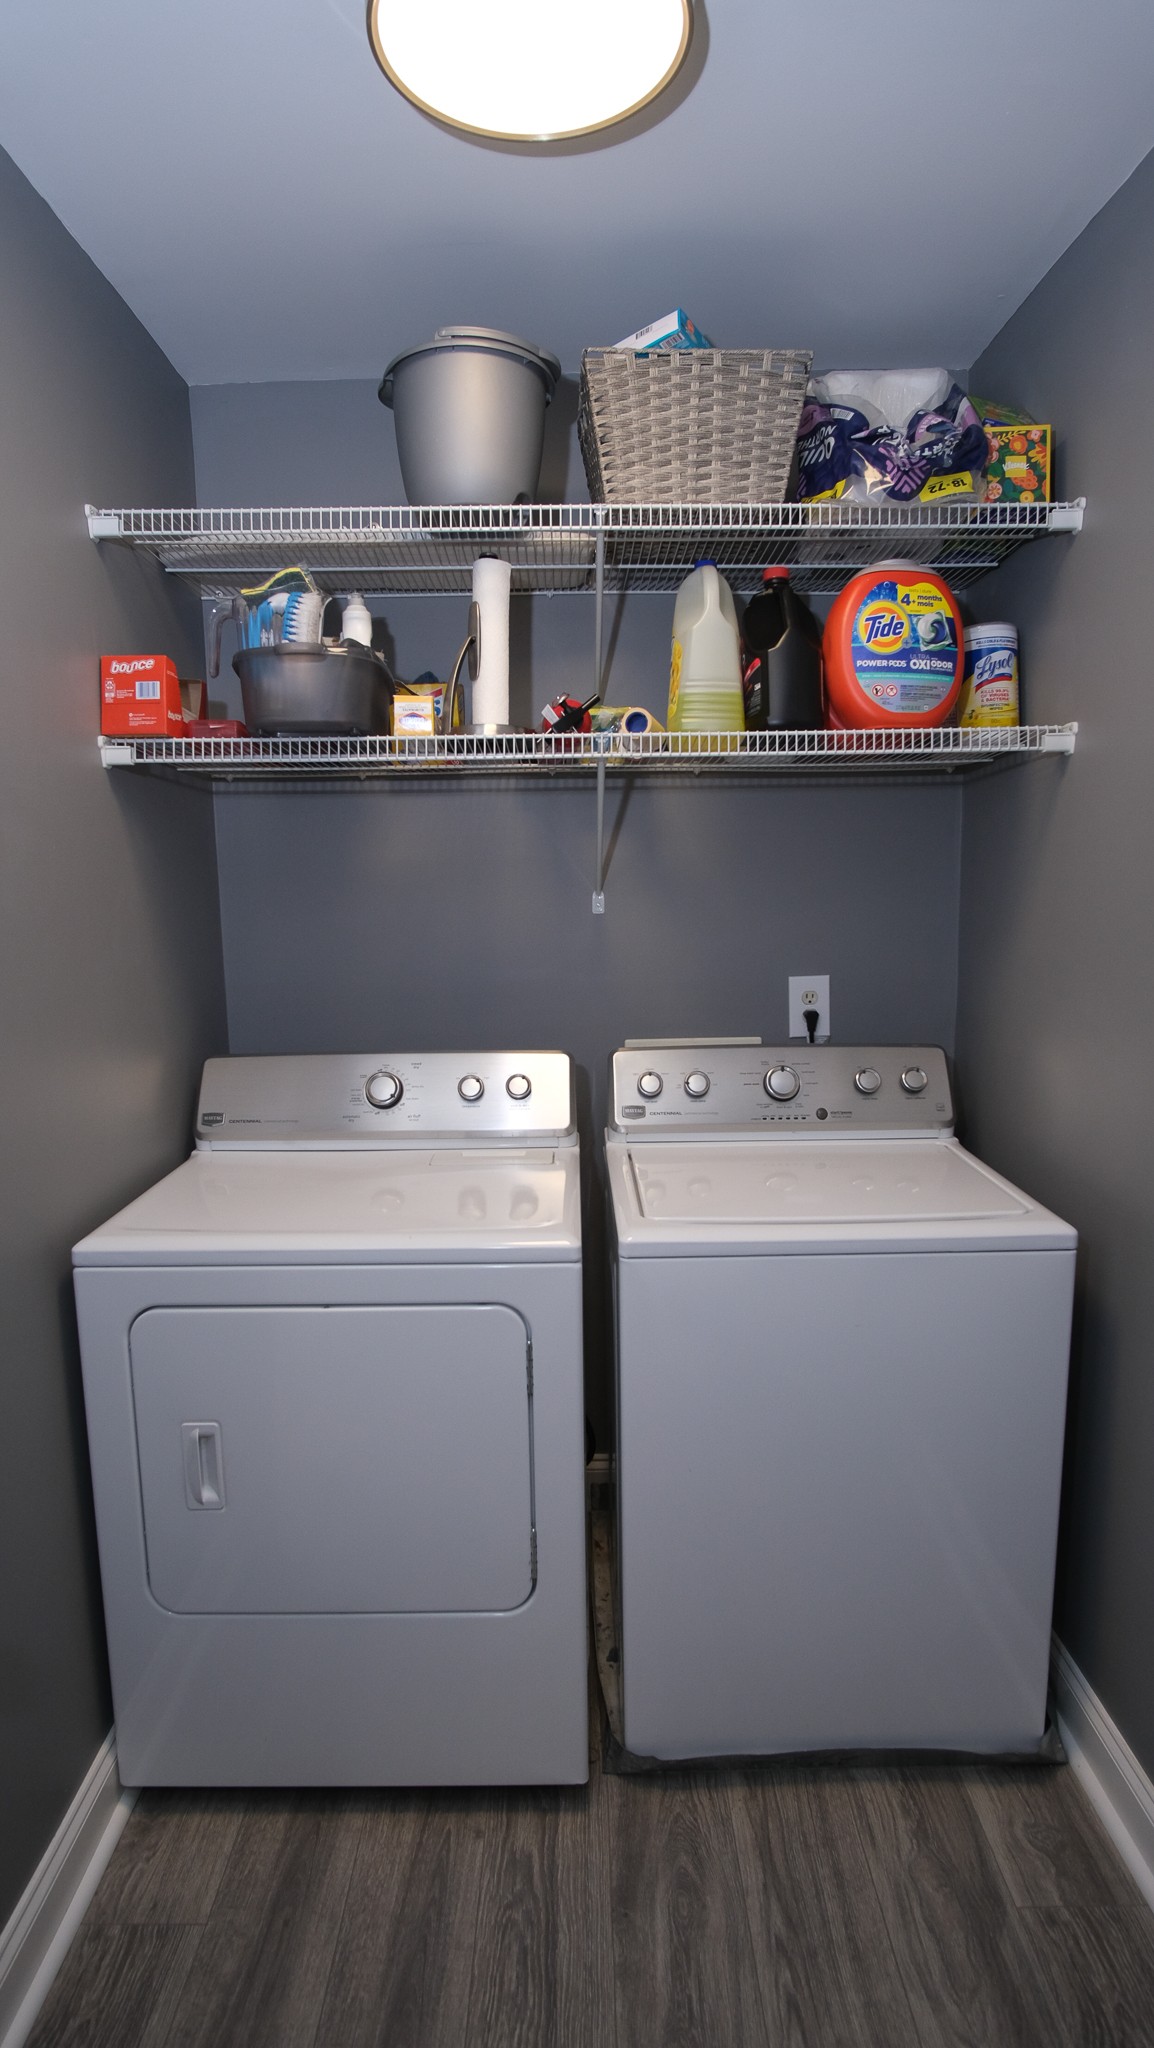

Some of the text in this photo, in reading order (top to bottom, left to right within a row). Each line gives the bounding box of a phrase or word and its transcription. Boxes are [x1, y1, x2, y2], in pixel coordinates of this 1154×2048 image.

[864, 614, 904, 644] Tide
[111, 658, 155, 674] bounce
[856, 660, 887, 668] POWER
[910, 659, 930, 670] OXI
[931, 660, 953, 668] ODOR
[976, 653, 1012, 679] Lysol
